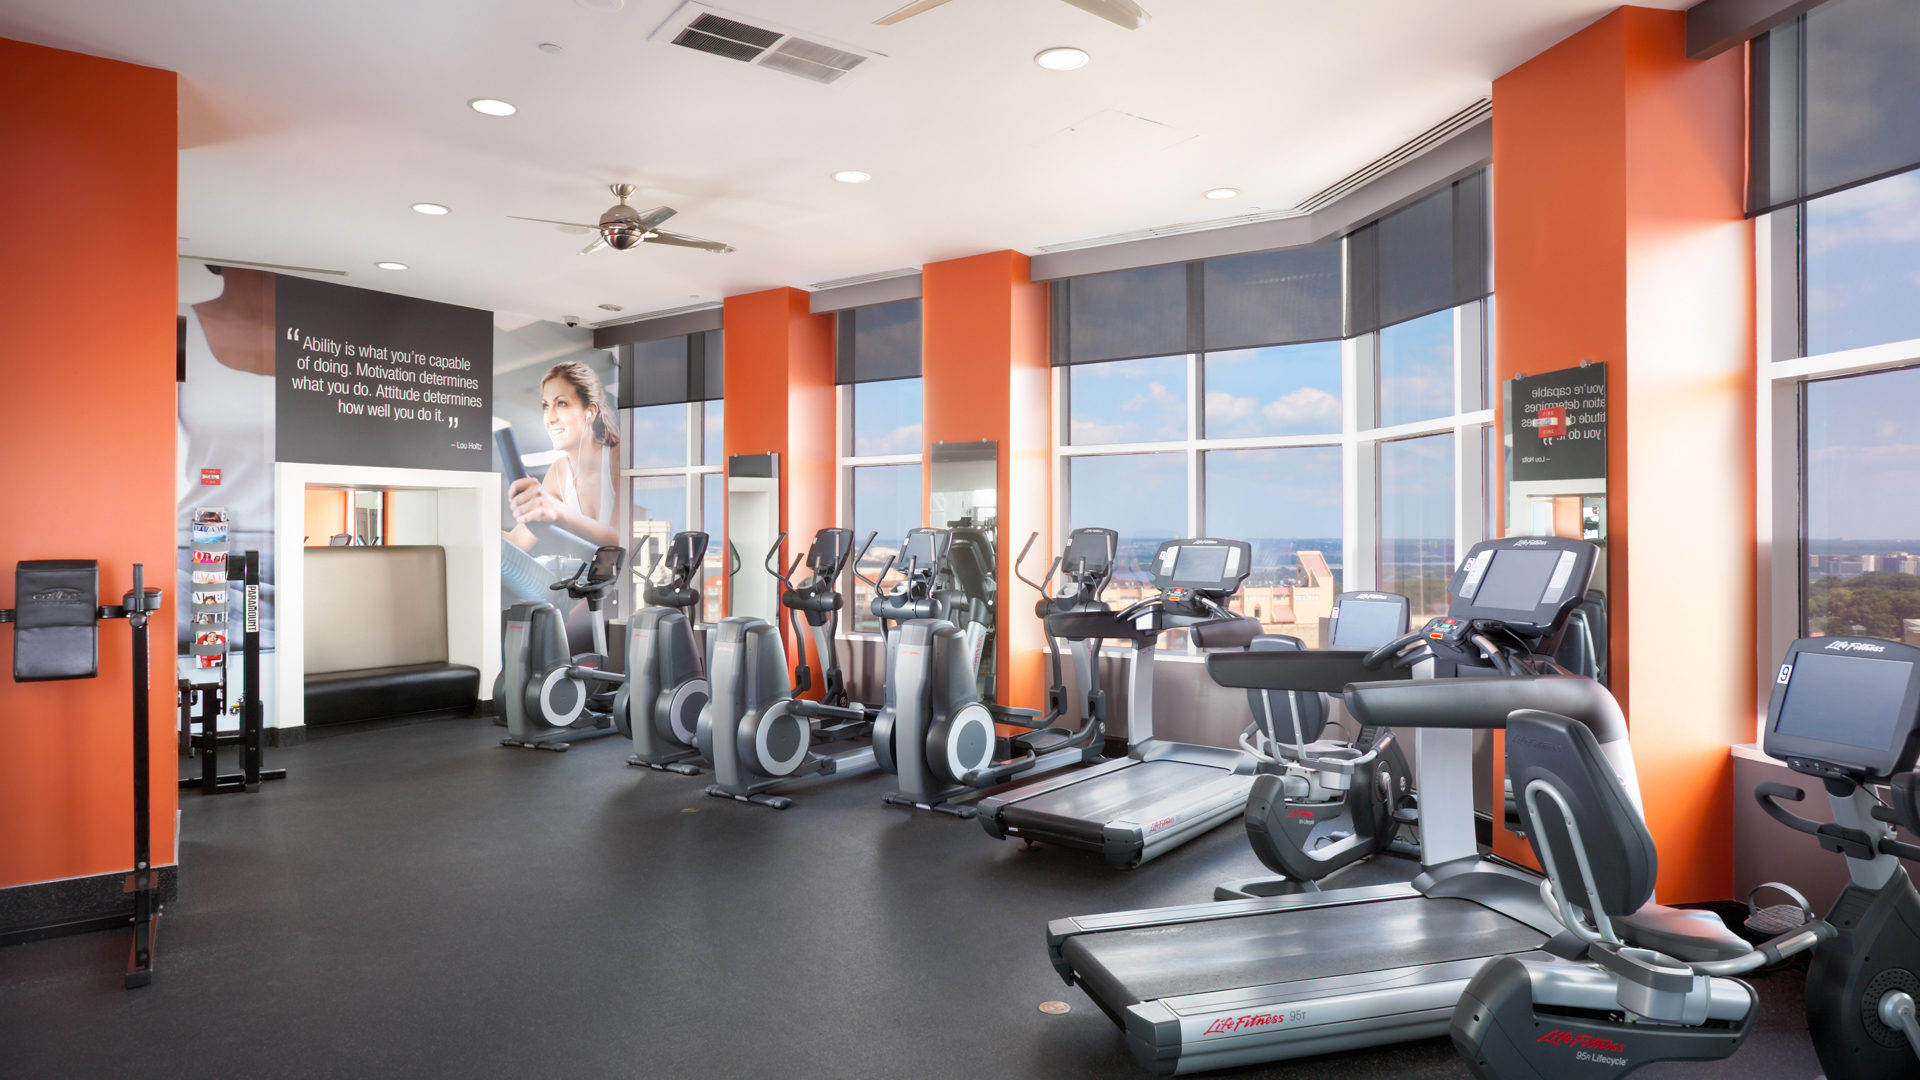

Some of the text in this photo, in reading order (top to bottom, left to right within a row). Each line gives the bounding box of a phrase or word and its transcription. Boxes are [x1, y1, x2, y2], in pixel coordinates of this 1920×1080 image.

[303, 336, 341, 357] Ability
[345, 341, 355, 356] is
[359, 345, 388, 360] what
[391, 350, 426, 365] you're
[429, 355, 471, 371] capable
[297, 356, 479, 389] of doing. Motivation determines
[292, 376, 483, 408] what you do. Attitude determines
[338, 399, 364, 415] how
[367, 404, 390, 417] well
[394, 407, 414, 421] you
[417, 407, 431, 421] do
[435, 408, 444, 422] it.
[457, 441, 467, 449] Lou
[468, 442, 483, 451] Holtz
[247, 586, 257, 631] PARAMOUNT
[1779, 666, 1790, 681] 9
